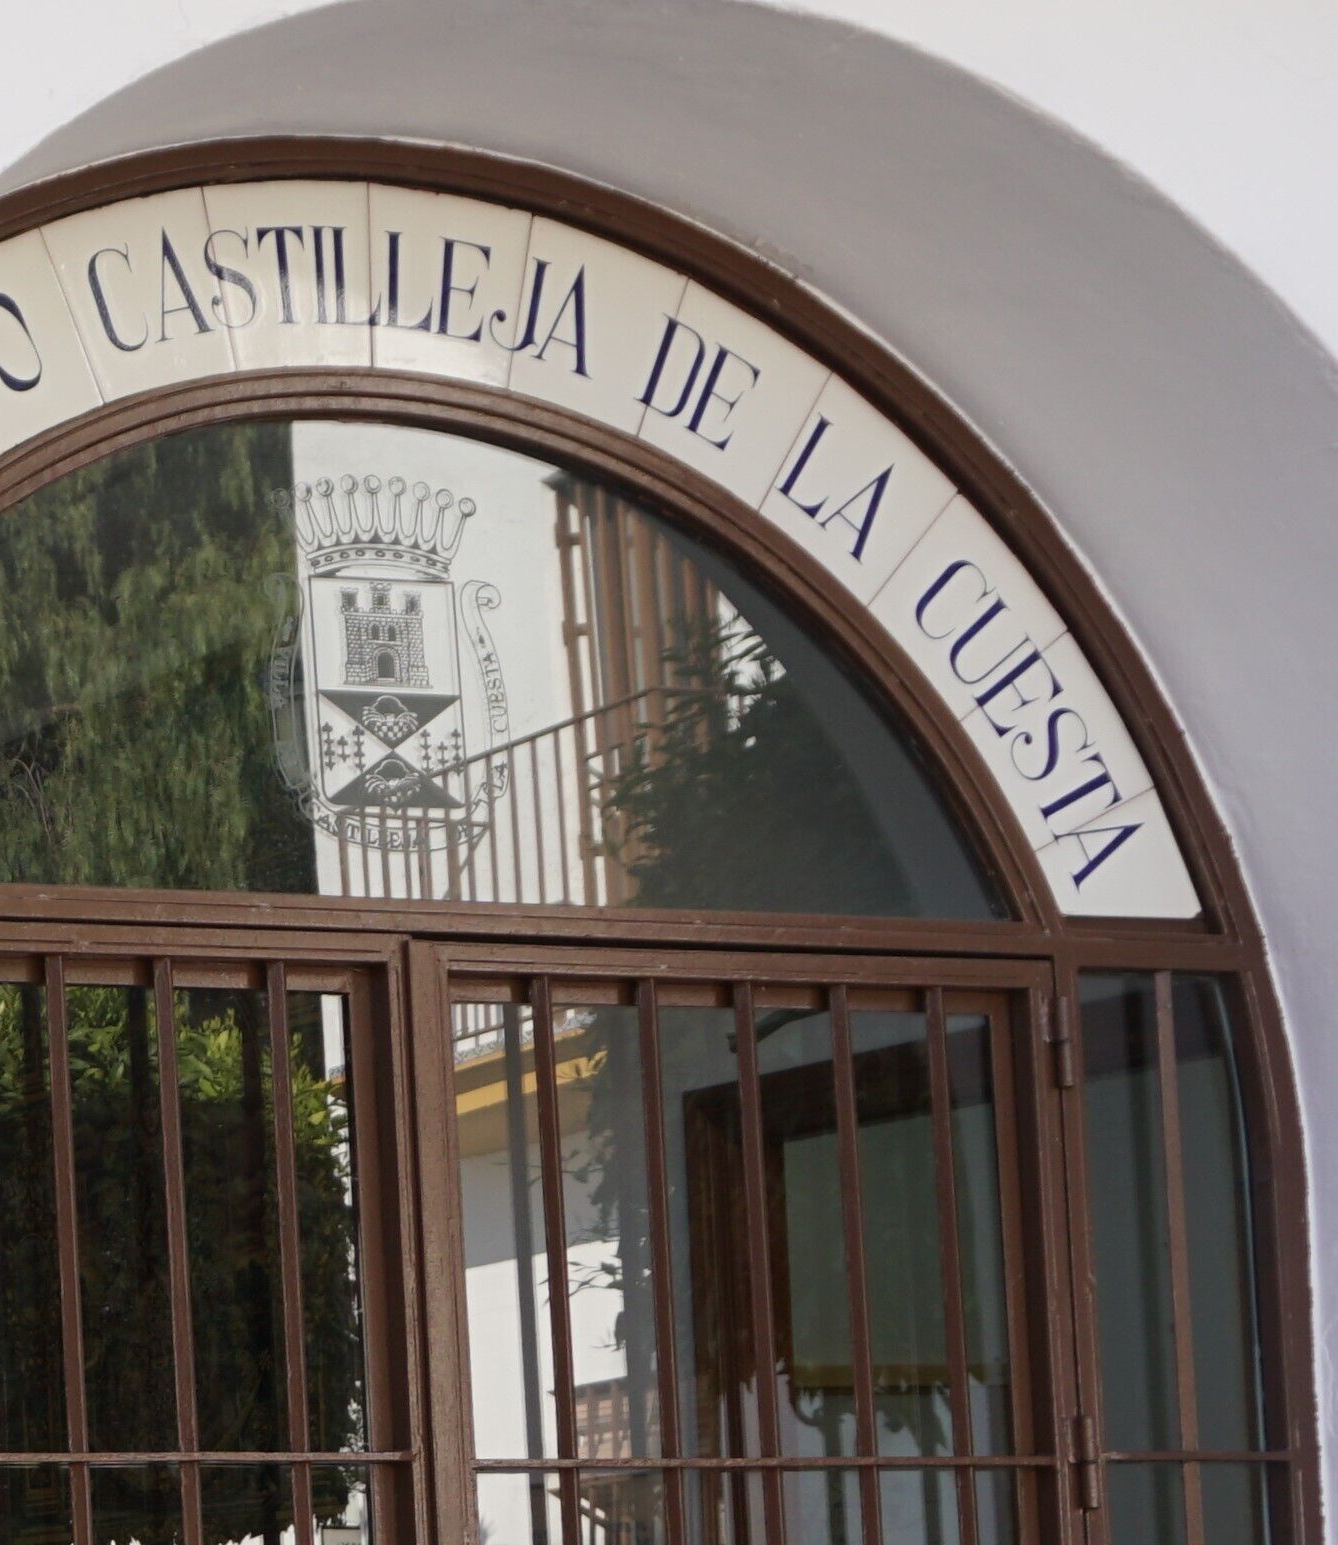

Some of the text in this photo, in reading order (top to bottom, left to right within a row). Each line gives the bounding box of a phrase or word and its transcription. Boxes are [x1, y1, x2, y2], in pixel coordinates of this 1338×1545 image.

[87, 225, 593, 380] CASTILLEJA
[633, 313, 761, 451] DE
[774, 414, 894, 564] LA
[915, 559, 1146, 894] CUESTA
